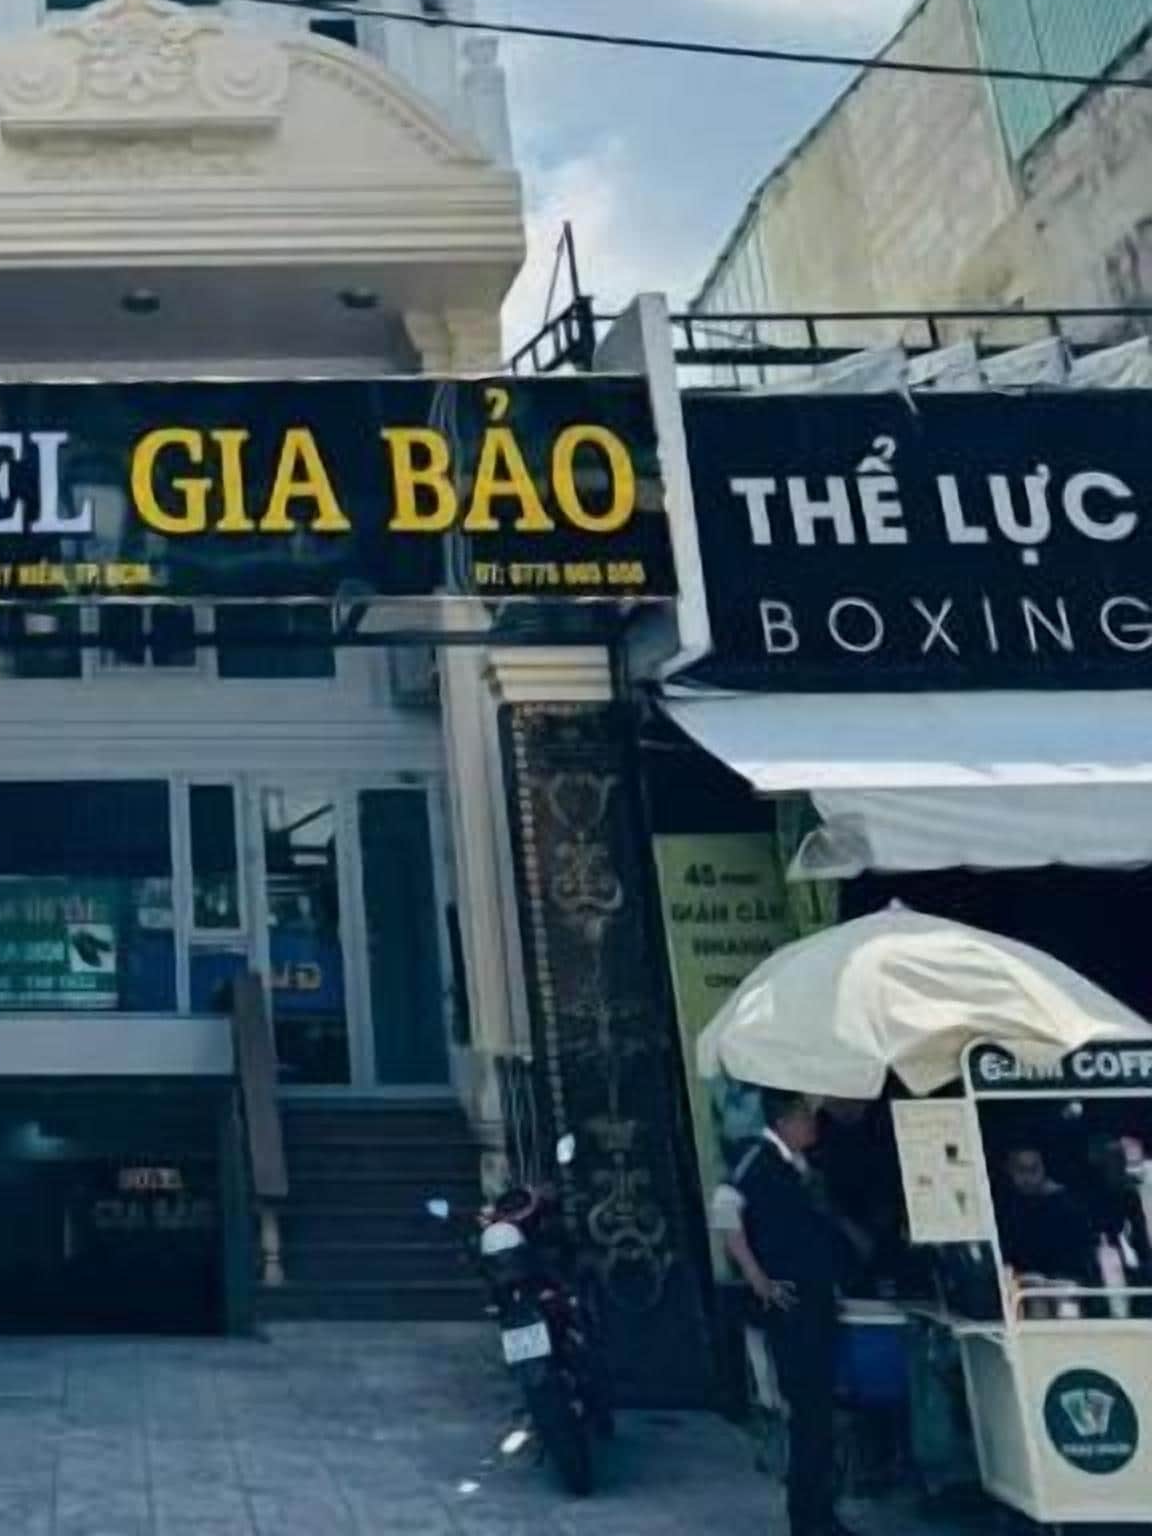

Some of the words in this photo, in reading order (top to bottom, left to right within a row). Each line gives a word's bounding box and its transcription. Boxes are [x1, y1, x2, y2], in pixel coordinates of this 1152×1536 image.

[130, 427, 351, 533] GIA
[380, 387, 636, 532] BẢO
[728, 435, 909, 545] THỂ
[937, 464, 1139, 565] LỰC
[759, 591, 1152, 654] BOXING
